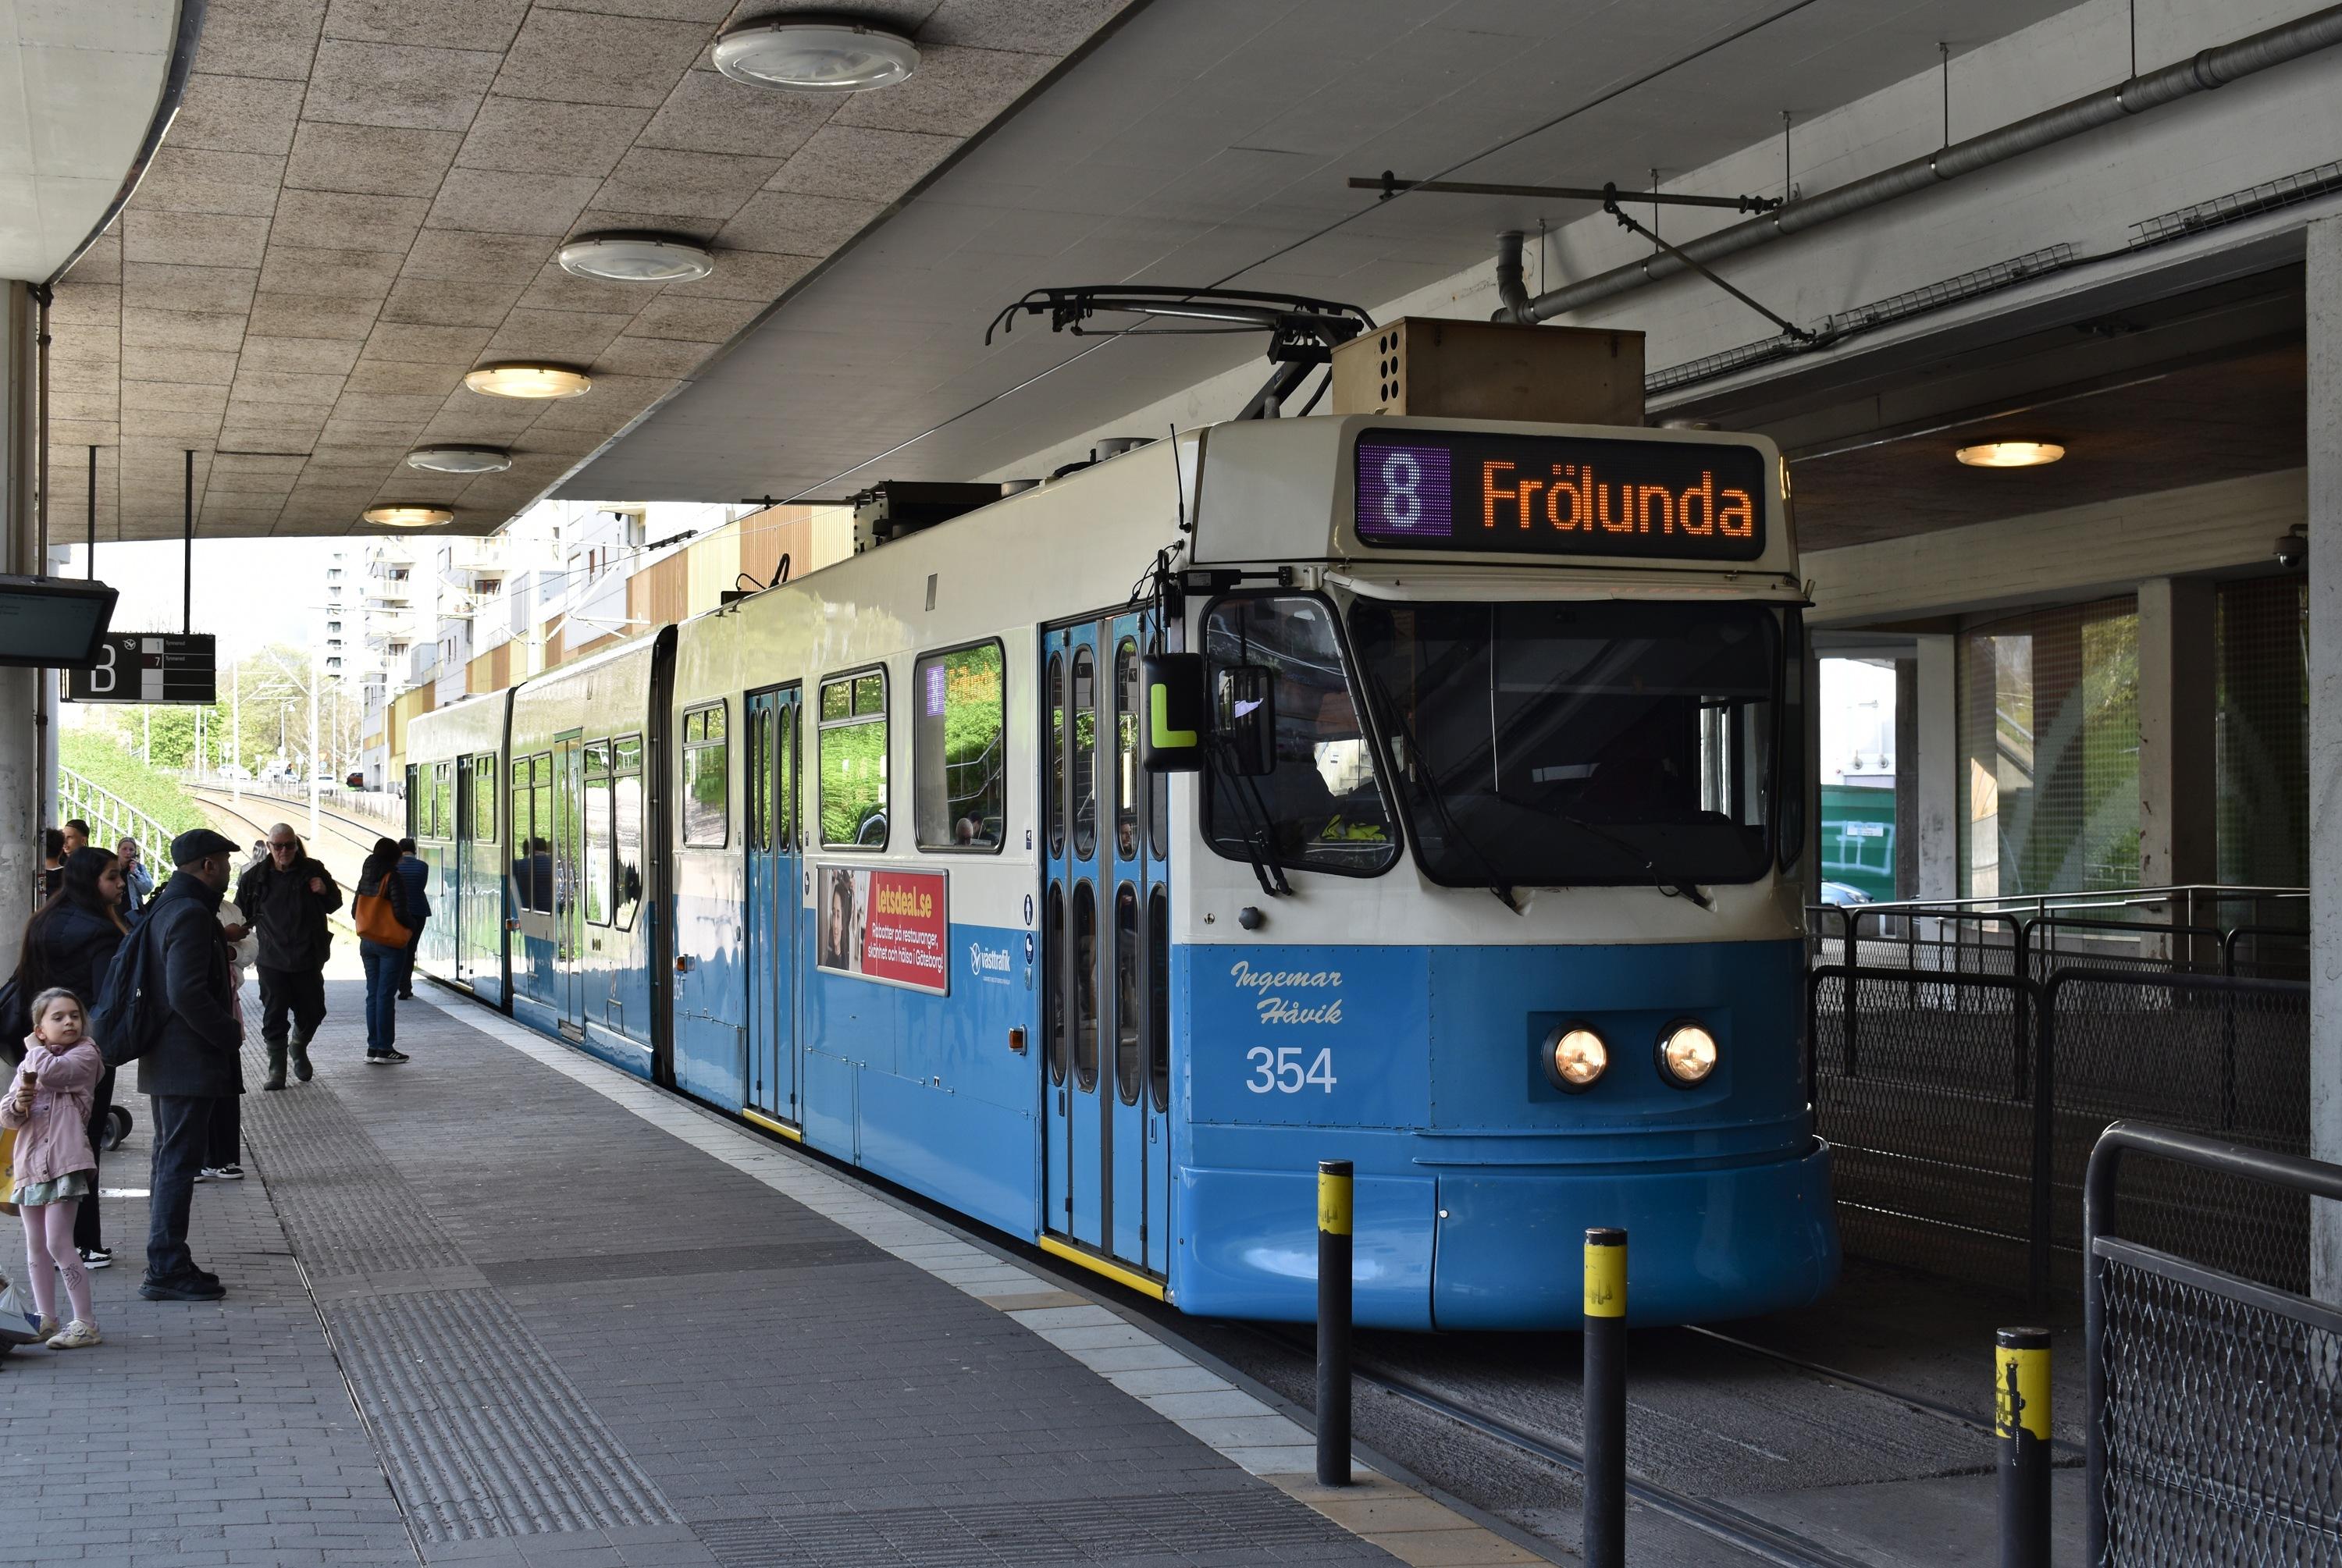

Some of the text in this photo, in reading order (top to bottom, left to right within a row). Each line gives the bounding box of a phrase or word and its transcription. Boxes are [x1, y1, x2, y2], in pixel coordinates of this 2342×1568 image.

[1382, 453, 1753, 538] 8 Frölunda
[90, 644, 116, 692] B
[155, 656, 161, 667] 7
[877, 883, 932, 919] letsdeal.se
[872, 923, 938, 950] Rabatter på restauranger,
[868, 942, 887, 961] skönhet
[888, 945, 898, 962] och
[898, 946, 913, 965] hälsa
[916, 949, 944, 974] Göteborg!
[981, 947, 1011, 972] västtrafik
[1230, 960, 1343, 996] Ingemar
[1256, 997, 1343, 1025] Håvik
[1246, 1046, 1337, 1093] 354
